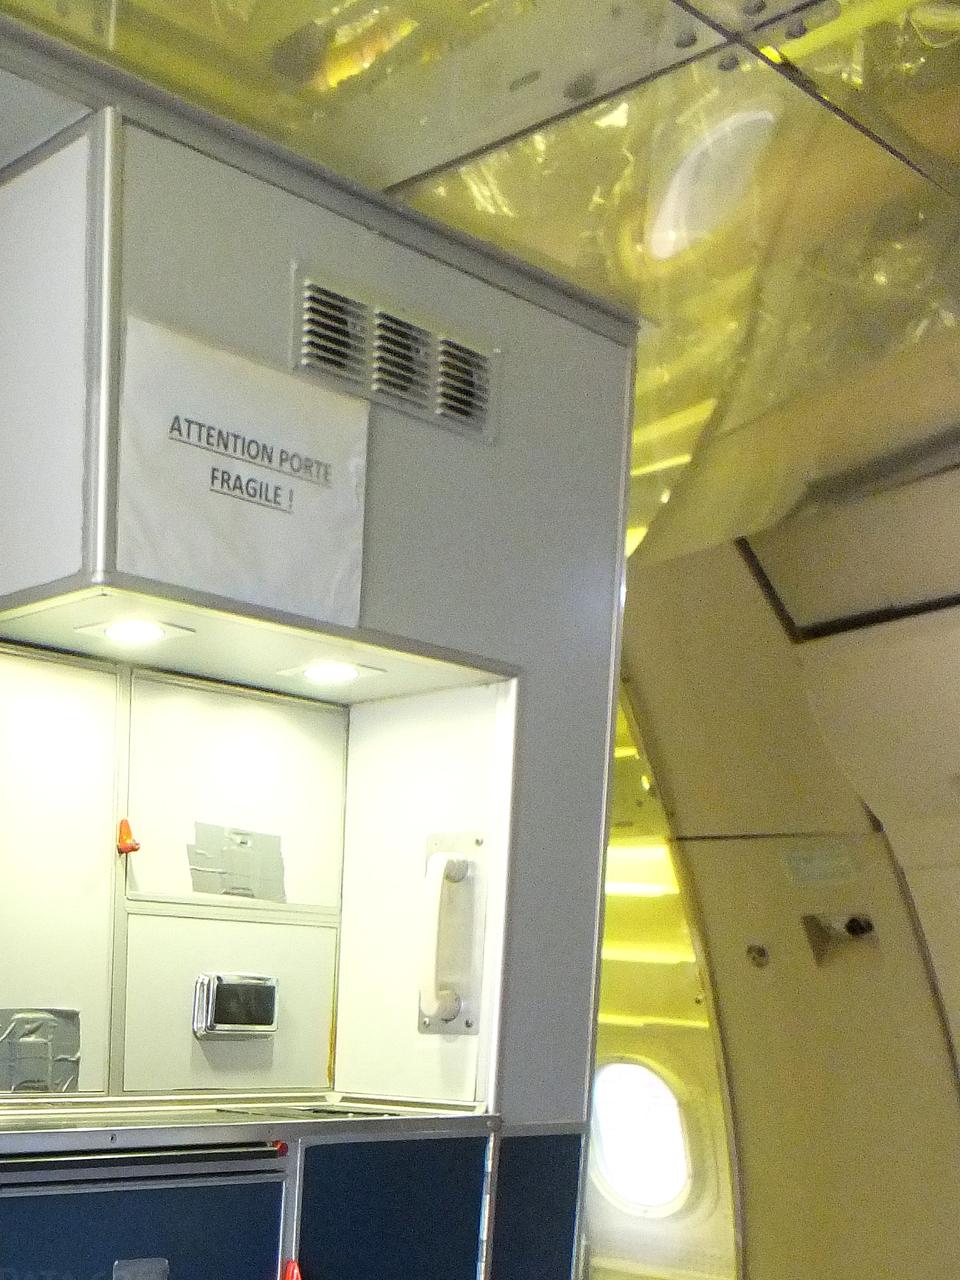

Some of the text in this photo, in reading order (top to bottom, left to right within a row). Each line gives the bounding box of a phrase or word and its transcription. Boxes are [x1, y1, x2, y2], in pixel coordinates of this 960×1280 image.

[168, 415, 333, 484] ATTENTION PORTE
[211, 467, 282, 506] FRAGILE
